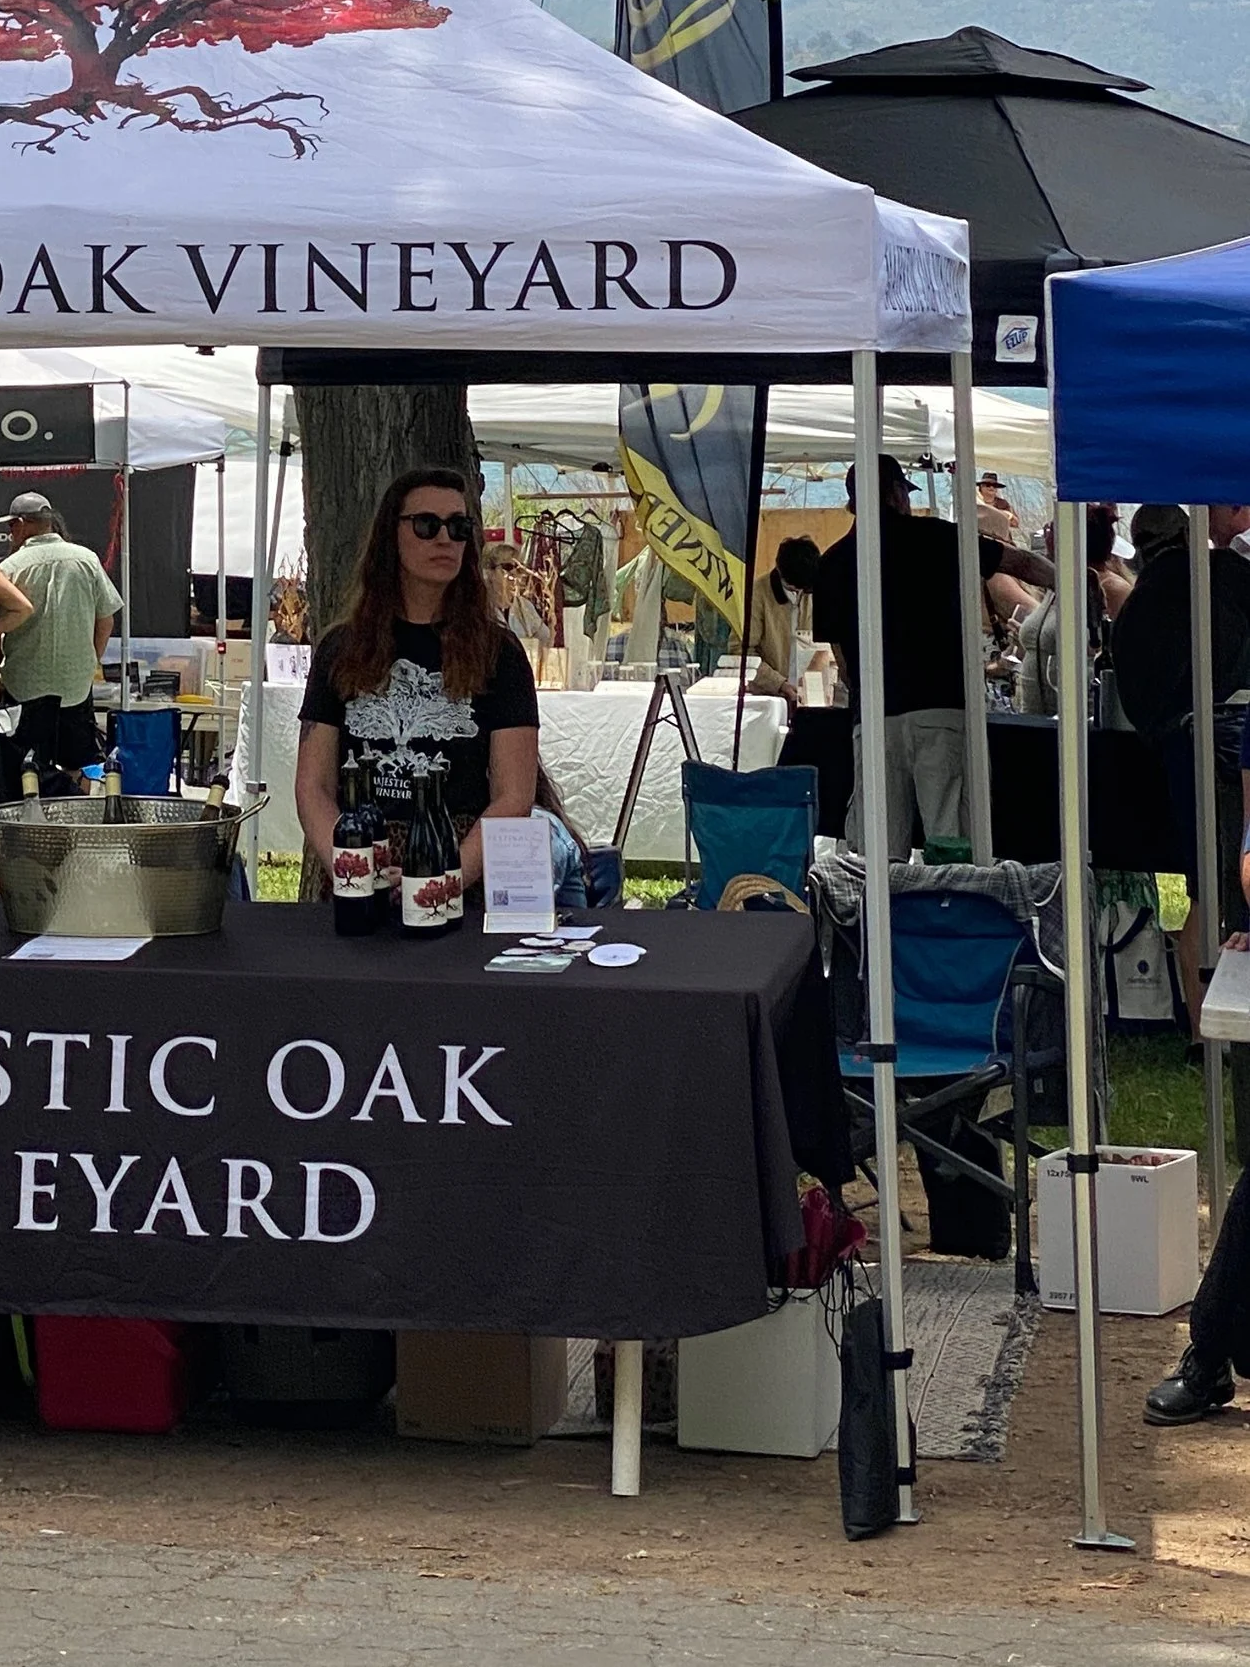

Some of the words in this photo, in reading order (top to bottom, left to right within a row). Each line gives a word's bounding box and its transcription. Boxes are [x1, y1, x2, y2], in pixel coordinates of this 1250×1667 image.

[177, 240, 736, 314] VINEYARD
[375, 787, 412, 799] VINEYAR
[267, 1040, 512, 1125] OAK
